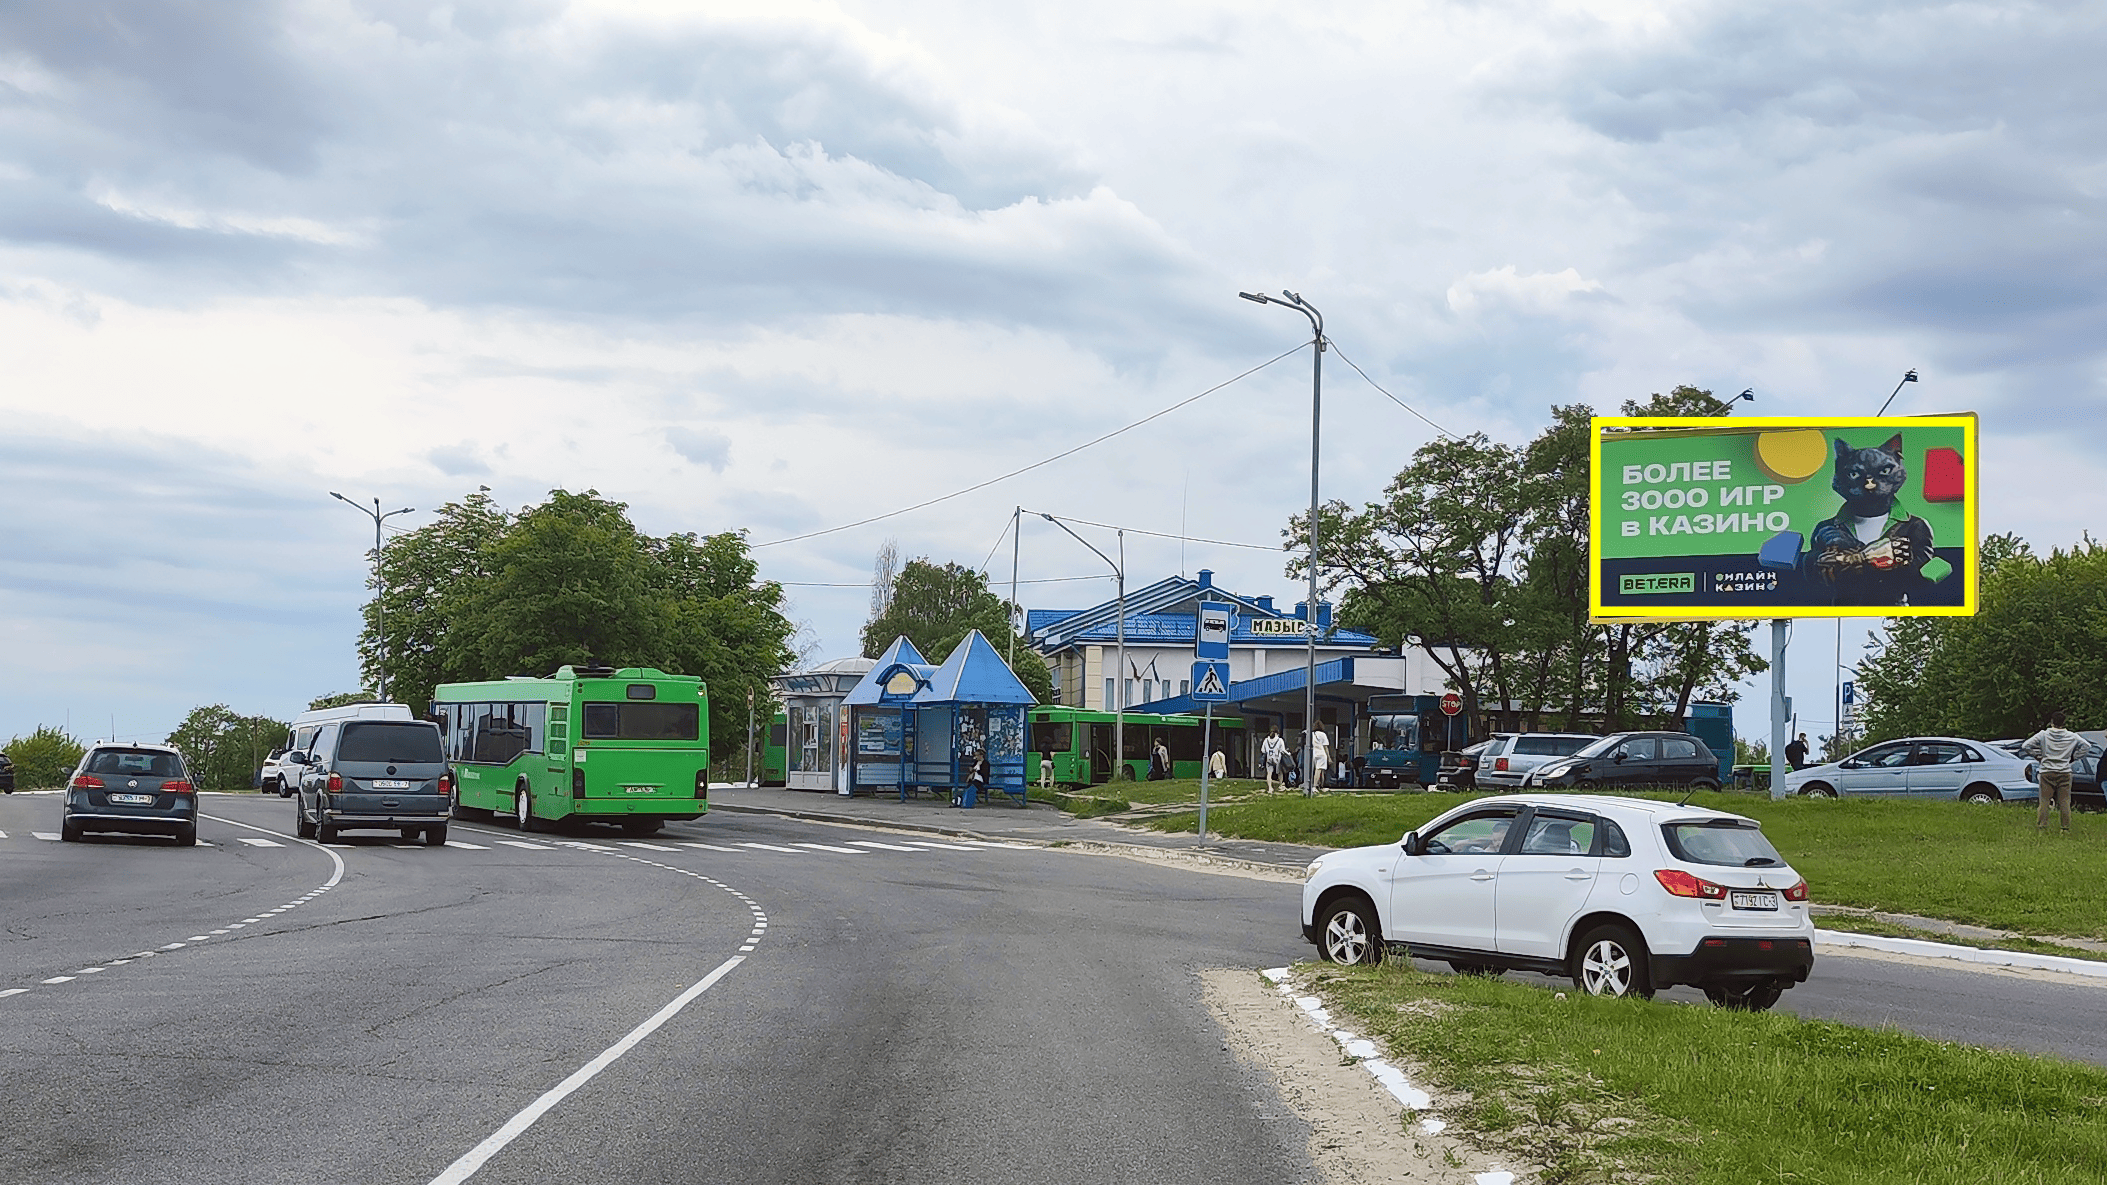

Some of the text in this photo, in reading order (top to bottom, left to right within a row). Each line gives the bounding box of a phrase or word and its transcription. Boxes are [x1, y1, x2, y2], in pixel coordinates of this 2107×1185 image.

[1622, 460, 1732, 485] БОЛЕЕ
[1621, 484, 1785, 511] 3000 ИГР
[1621, 511, 1790, 537] в КАЗИНО
[1715, 570, 1777, 582] ОНЛАЙН
[1844, 684, 1851, 702] P
[1442, 700, 1461, 708] STOP
